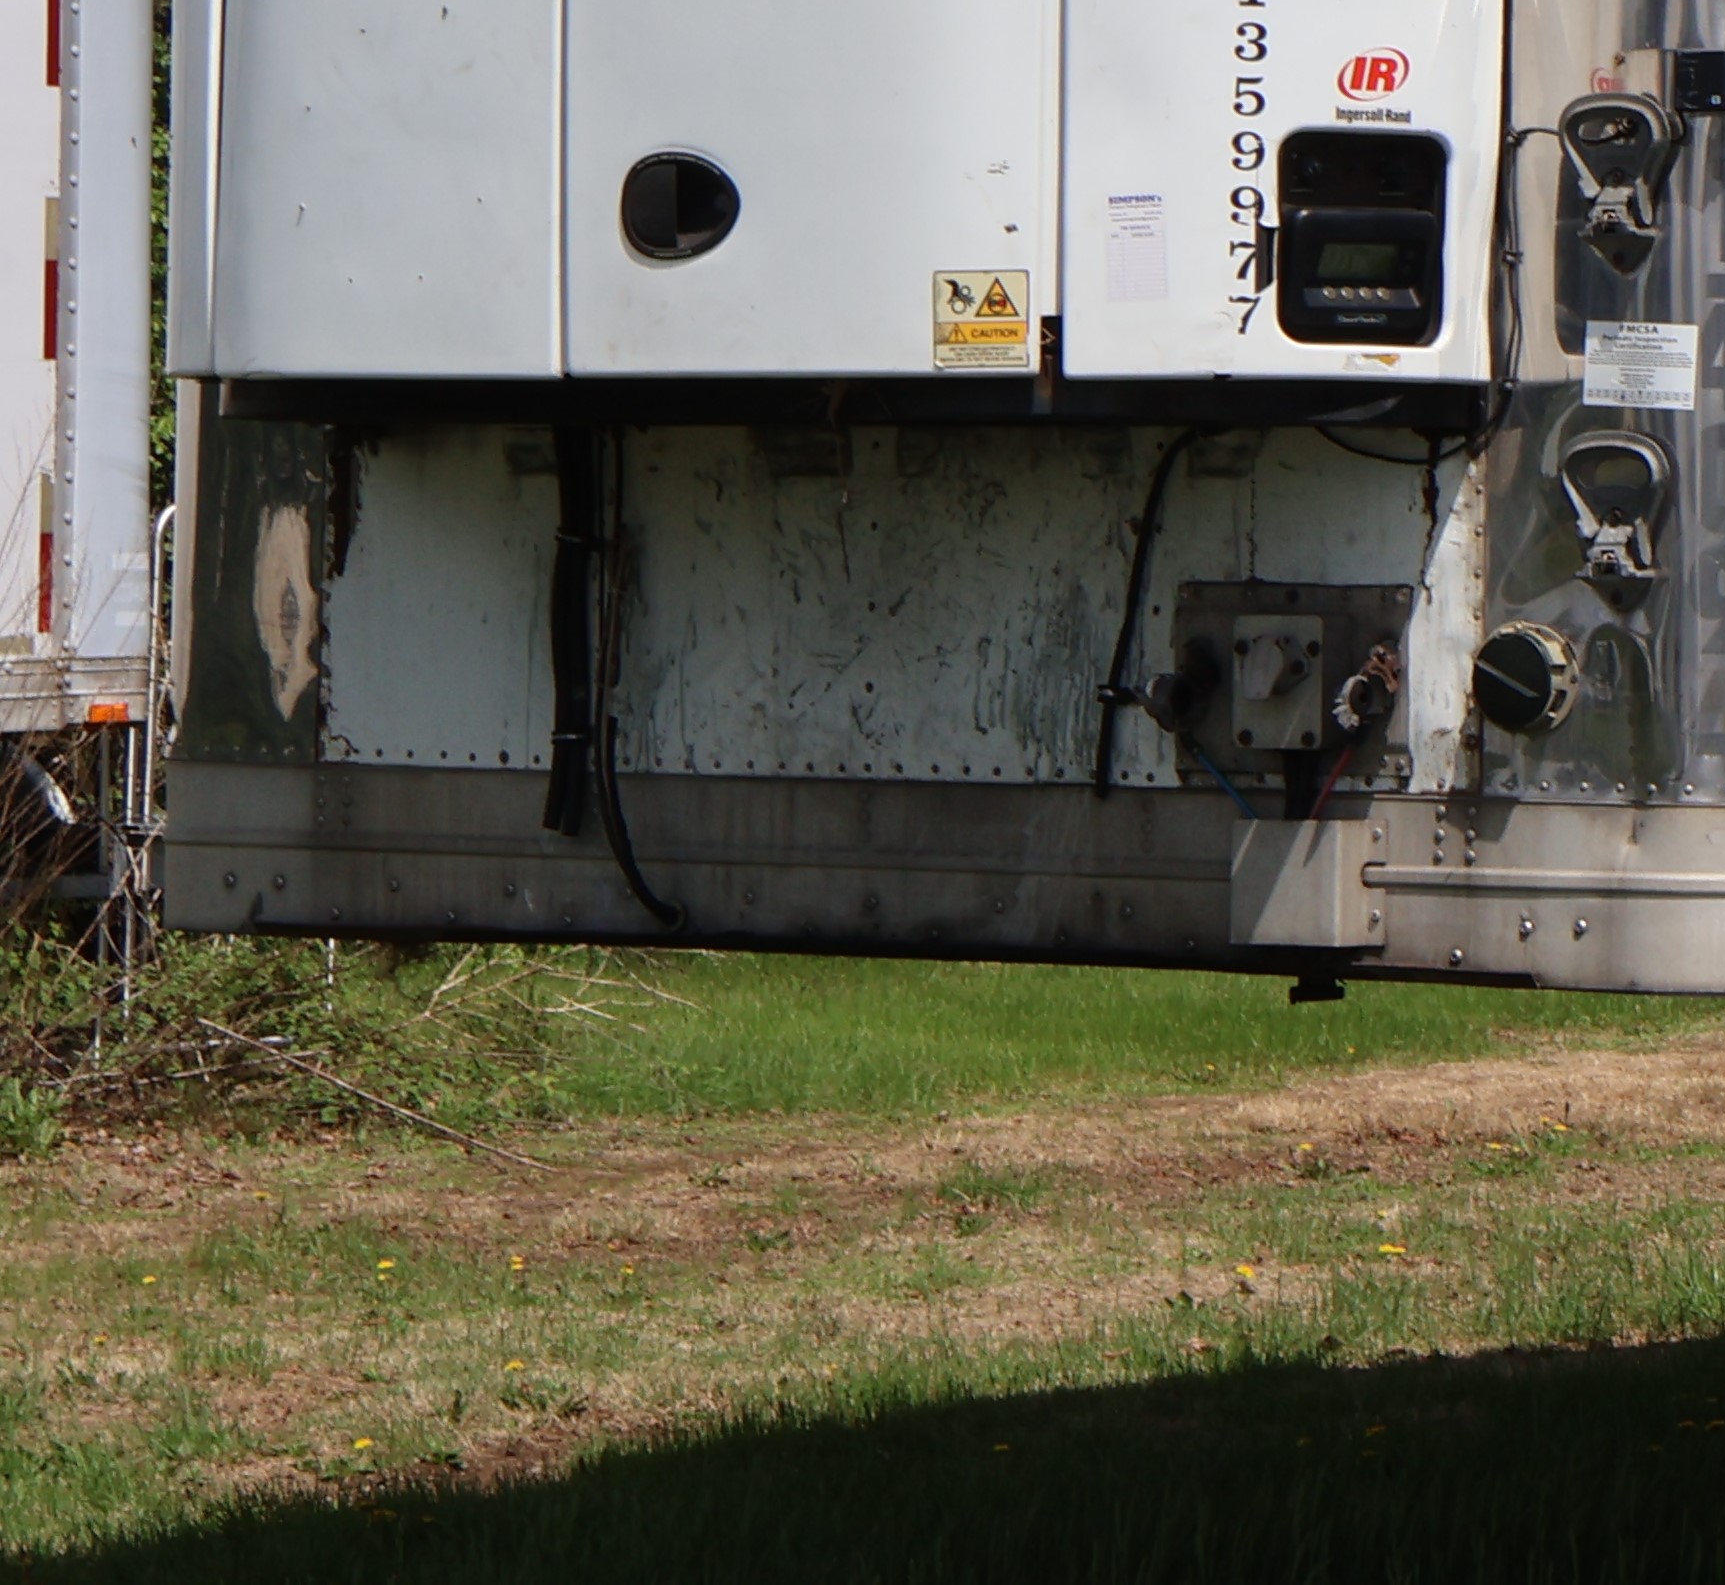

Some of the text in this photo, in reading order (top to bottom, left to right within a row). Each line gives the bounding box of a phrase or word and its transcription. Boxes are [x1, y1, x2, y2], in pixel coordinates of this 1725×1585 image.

[1351, 56, 1398, 91] IR
[1336, 107, 1383, 123] Ingersoll
[971, 329, 1018, 338] CAUTION
[1619, 325, 1658, 333] FMCSA
